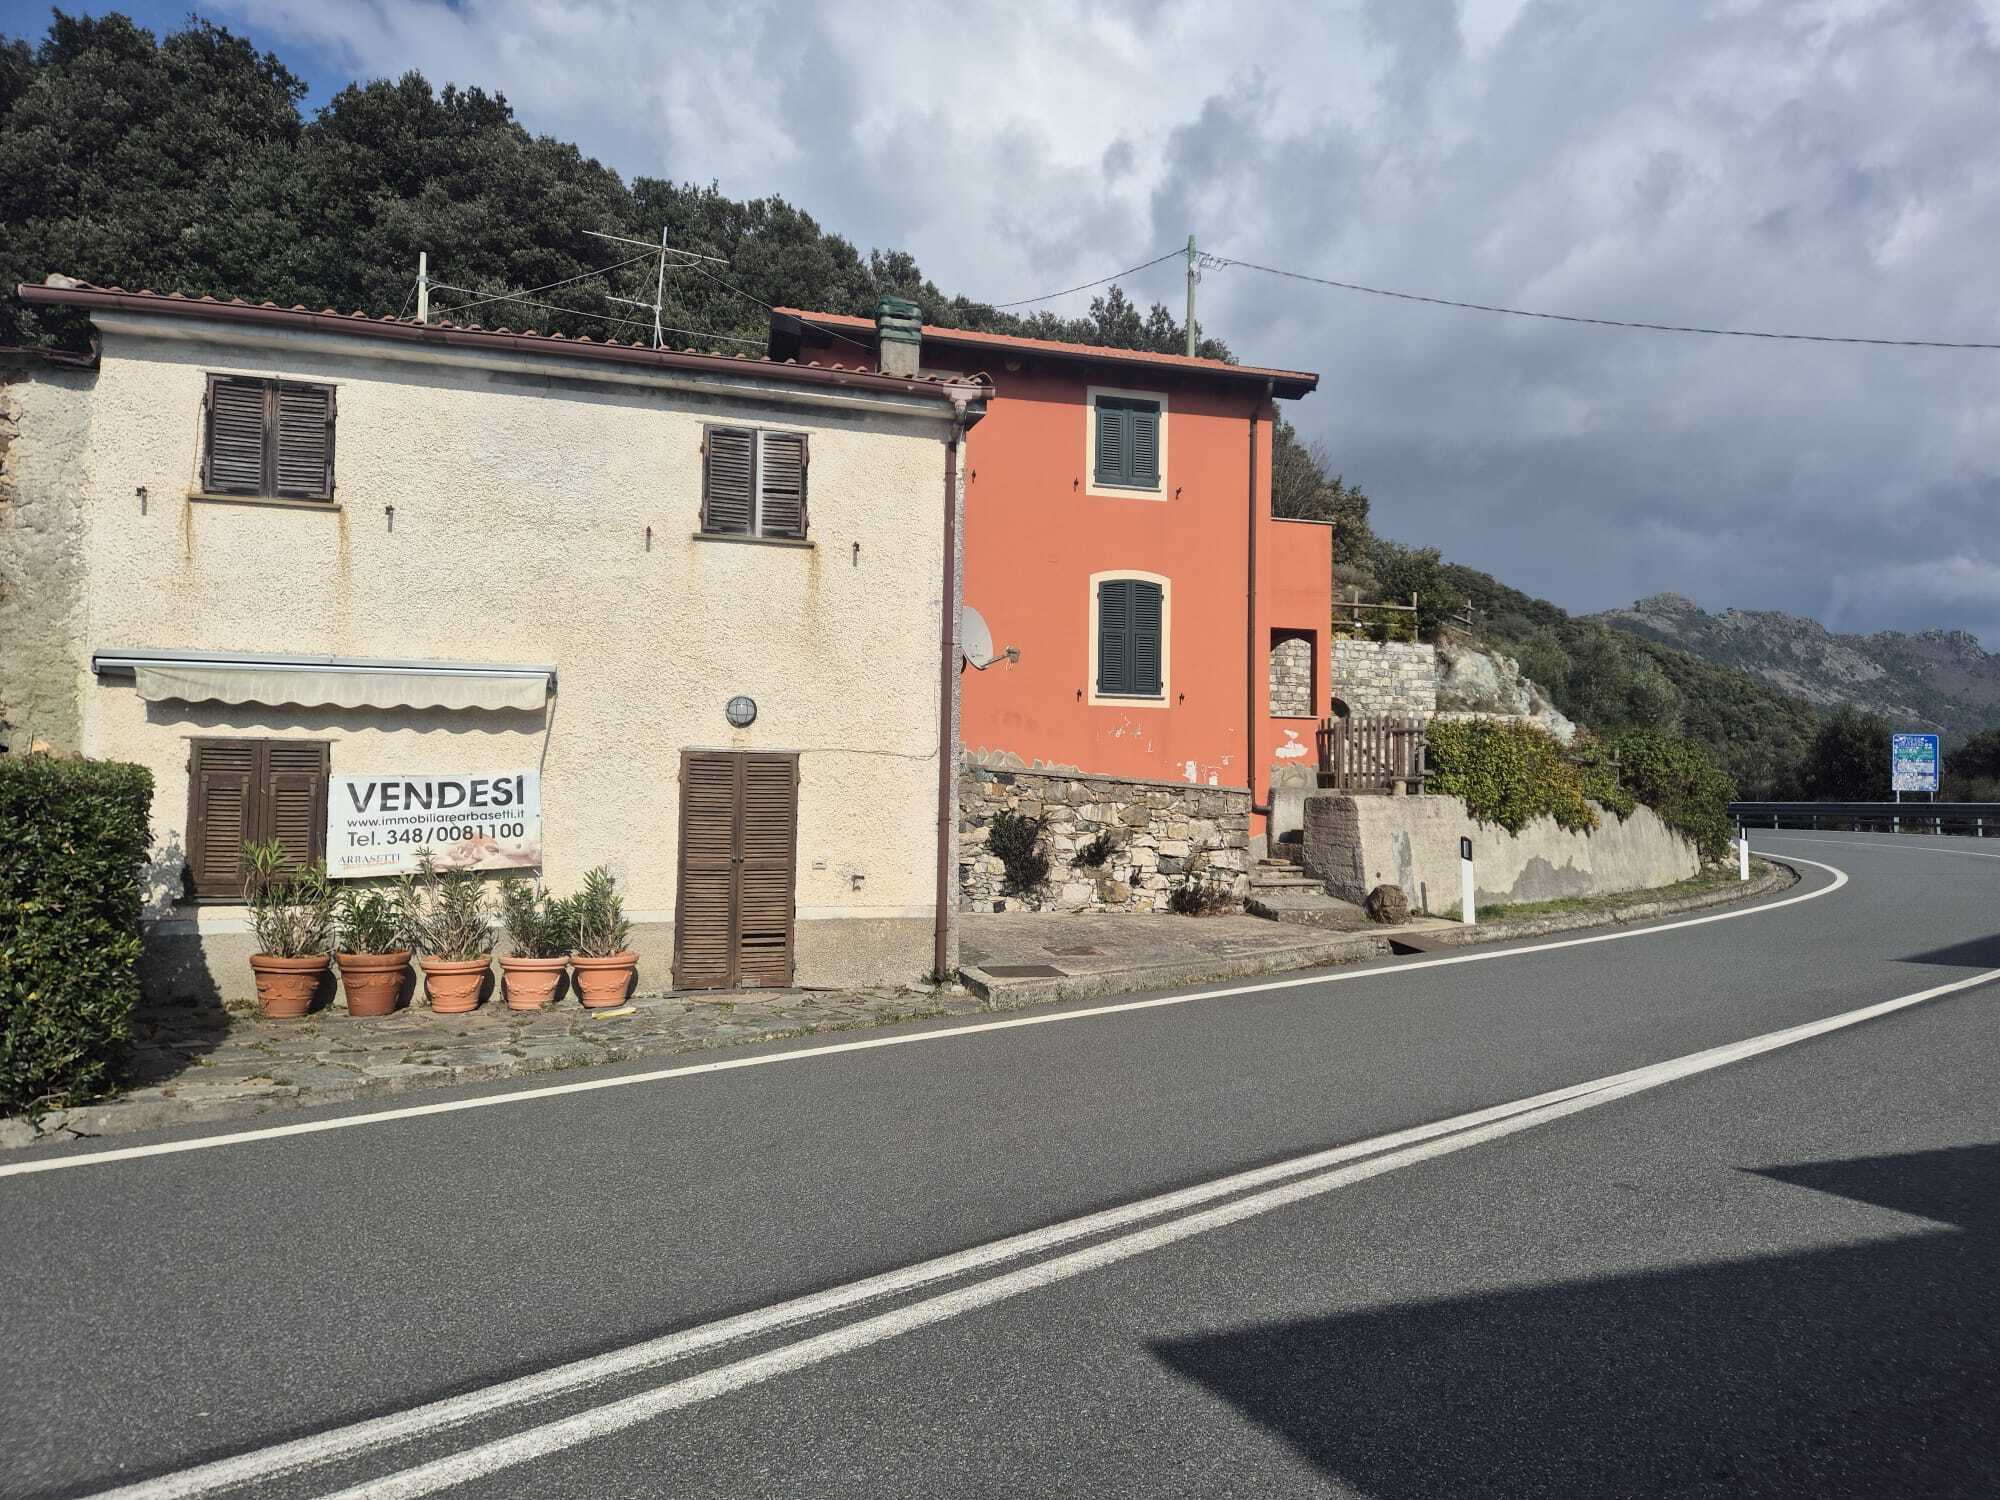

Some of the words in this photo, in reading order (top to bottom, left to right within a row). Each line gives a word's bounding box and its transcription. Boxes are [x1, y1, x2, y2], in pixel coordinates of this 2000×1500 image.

[346, 775, 525, 813] VENDESI
[347, 809, 525, 828] www.immobiliarearbasetti.it
[347, 831, 381, 847] Tel.
[386, 823, 524, 844] 348/0081100
[337, 852, 401, 866] ARBASETTI
